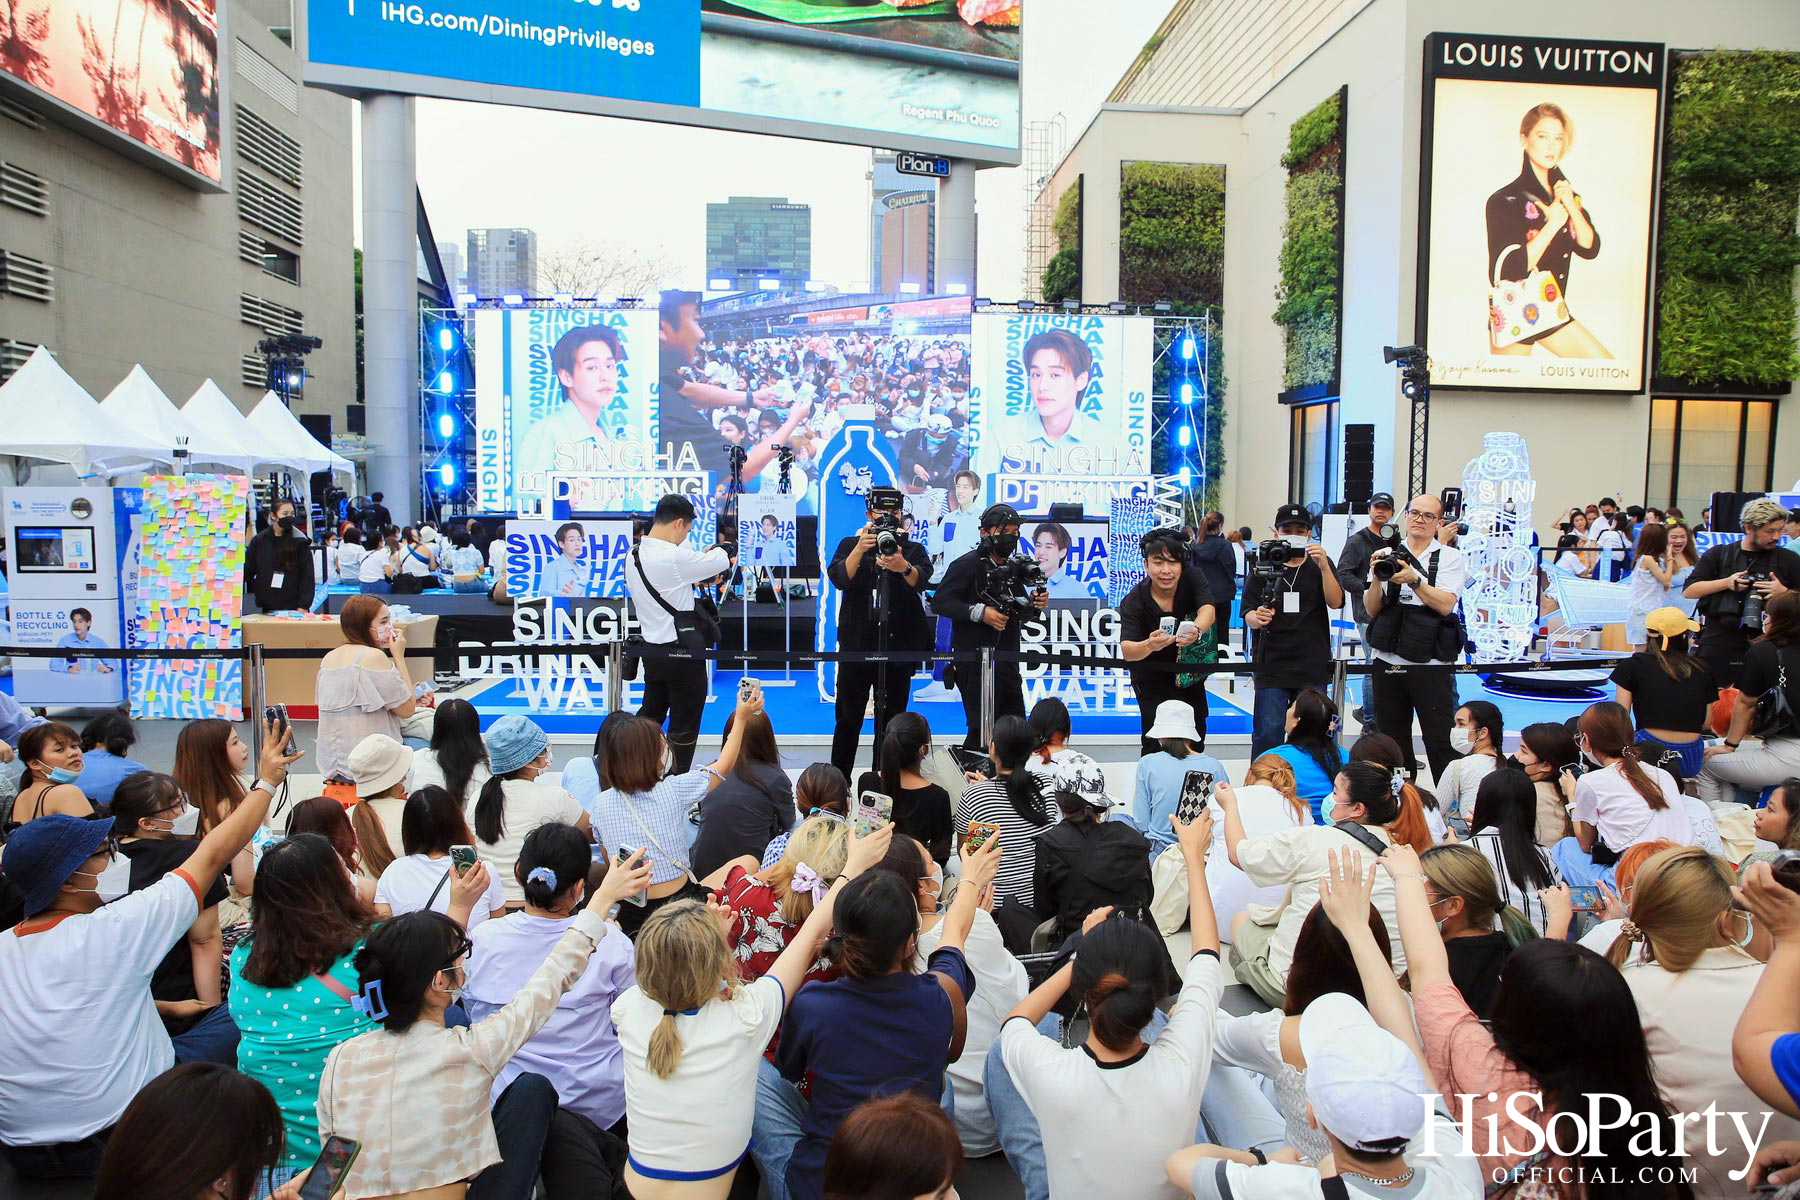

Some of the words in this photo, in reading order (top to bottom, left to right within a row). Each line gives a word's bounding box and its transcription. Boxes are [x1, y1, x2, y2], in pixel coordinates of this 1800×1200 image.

[381, 1, 655, 56] IHG.com/DiningPrivileges
[1443, 42, 1524, 68] LOUIS
[1534, 46, 1654, 74] VUITTON
[902, 103, 944, 121] Regent
[946, 109, 968, 124] Phu
[969, 113, 1000, 128] Quoc
[1540, 365, 1575, 377] LOUIS
[1580, 367, 1630, 379] VUITTON
[552, 440, 701, 472] SINGHA
[1002, 444, 1145, 475] SINGHA
[552, 476, 704, 502] DRINKING
[1002, 479, 1147, 503] DRINKING
[16, 611, 53, 620] BOTTLE
[16, 621, 69, 630] RECYCLING
